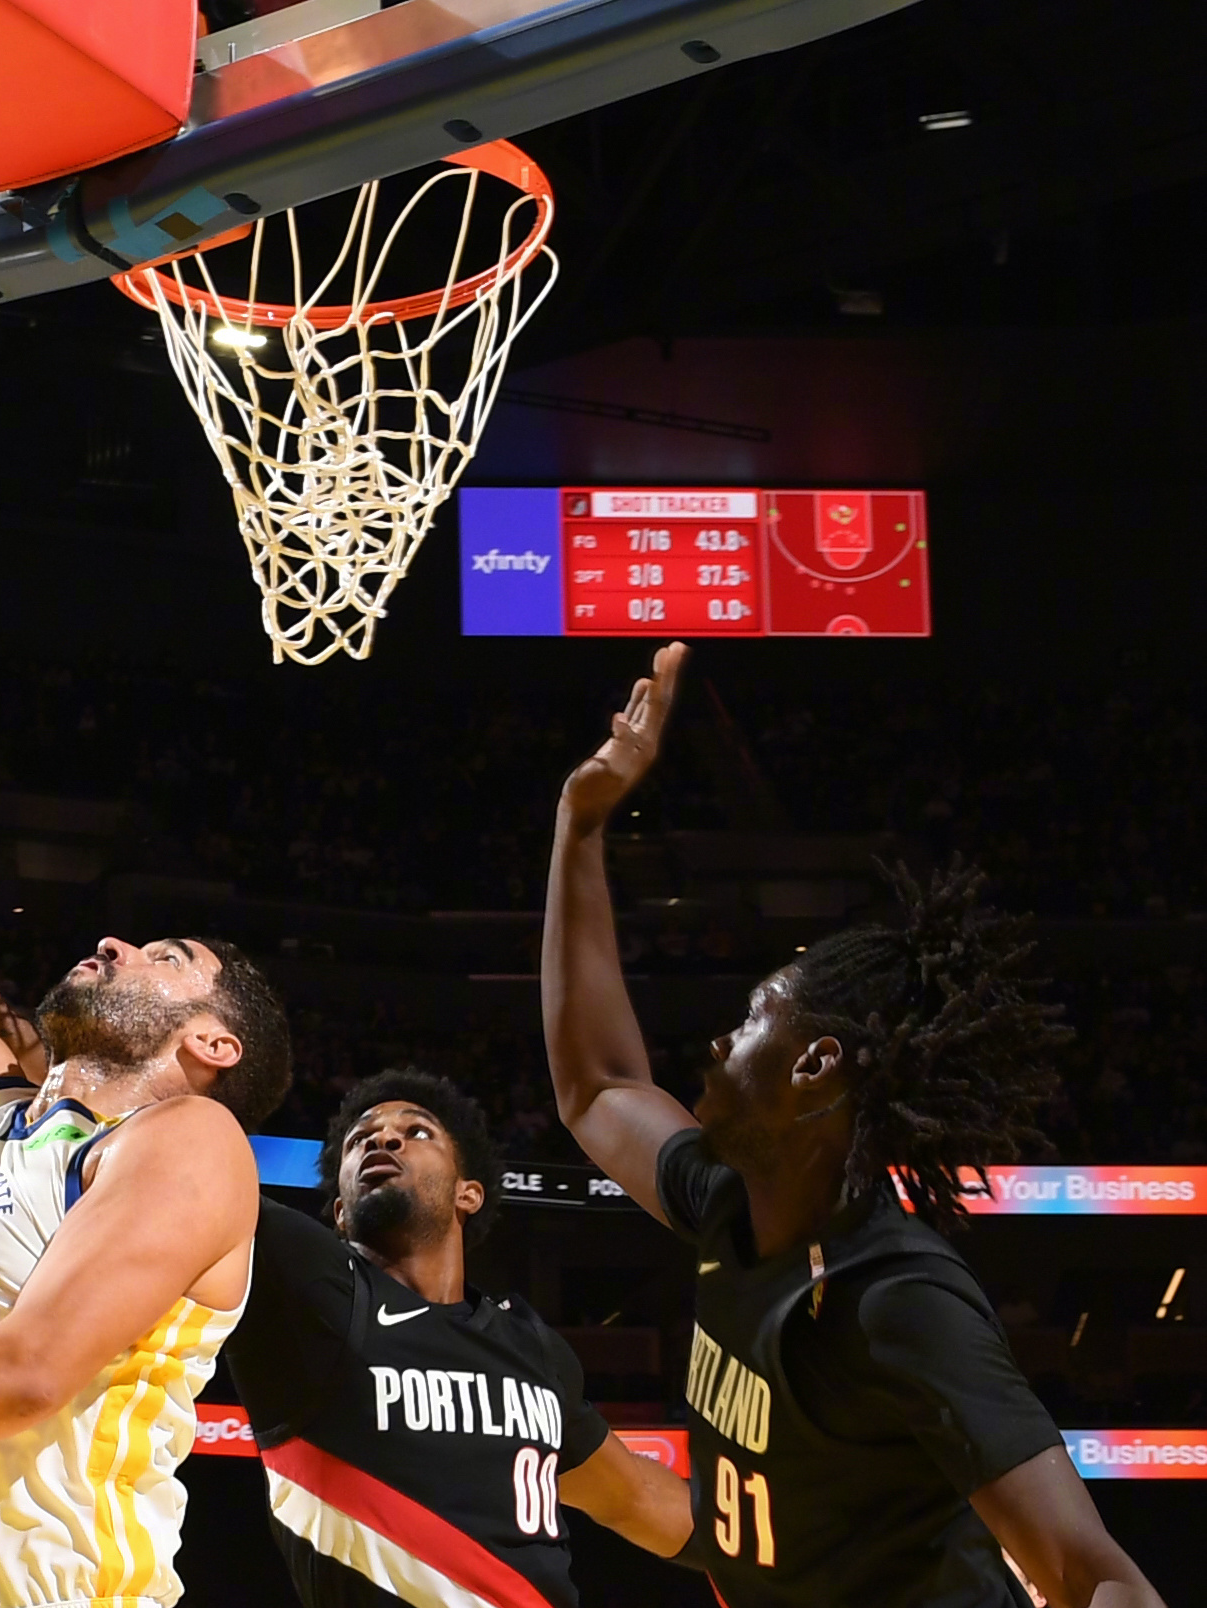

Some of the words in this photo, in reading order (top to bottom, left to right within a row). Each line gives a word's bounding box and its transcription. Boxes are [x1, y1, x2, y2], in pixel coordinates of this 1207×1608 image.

[611, 496, 651, 513] SHOT
[658, 497, 730, 513] TRACKER
[573, 534, 598, 549] FG
[627, 529, 672, 552] 7/16
[471, 549, 552, 575] xfinity
[627, 564, 664, 588] 3/8
[574, 604, 597, 618] FT
[628, 599, 666, 622] 0/2
[588, 1178, 628, 1197] POS
[995, 1174, 1062, 1201] Your
[1065, 1174, 1196, 1201] Business
[686, 1320, 772, 1456] RTLAND
[368, 1366, 562, 1450] PORTLAND
[1079, 1437, 1207, 1465] Business
[513, 1446, 559, 1539] 00
[714, 1454, 776, 1568] 91
